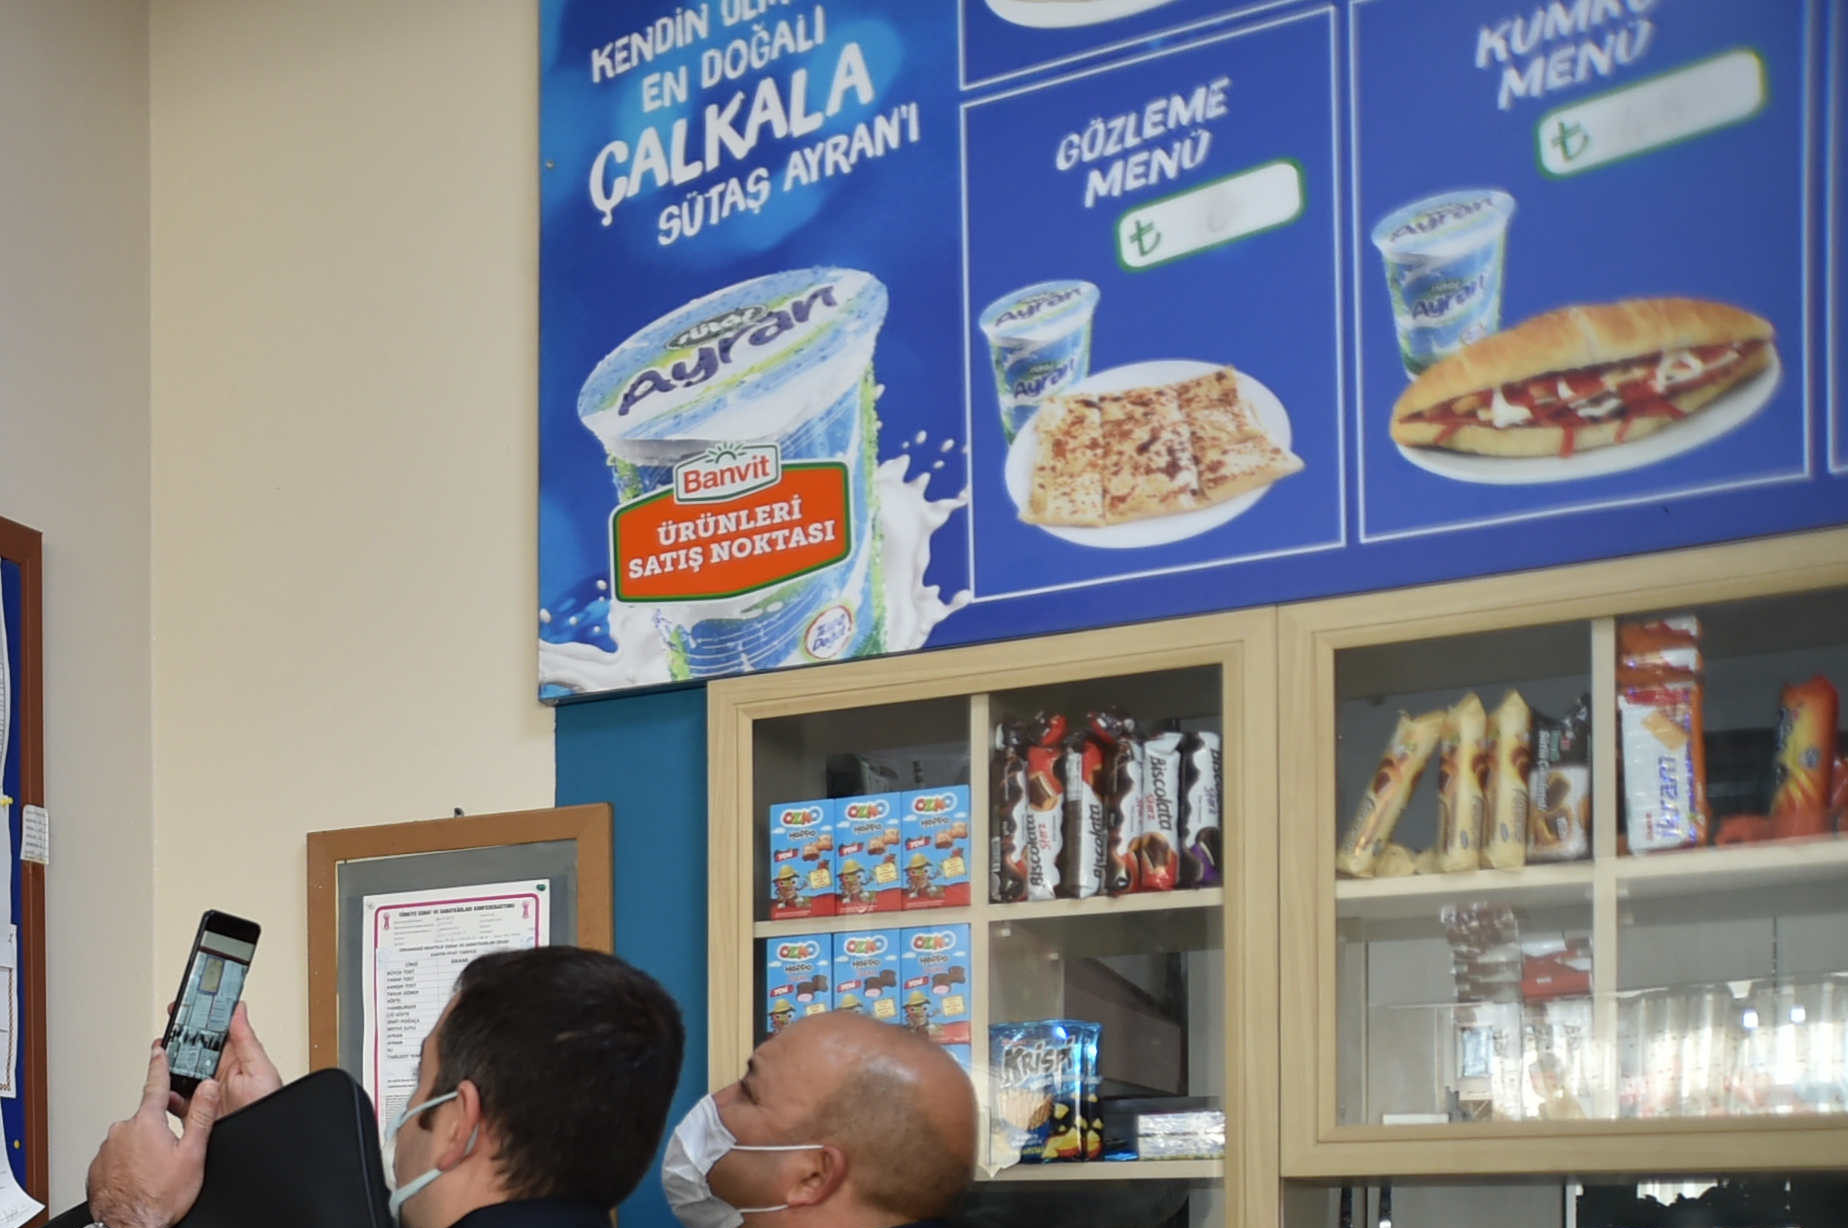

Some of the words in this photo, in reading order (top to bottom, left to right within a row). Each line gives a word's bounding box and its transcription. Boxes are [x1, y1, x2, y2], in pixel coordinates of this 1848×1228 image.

[591, 3, 709, 84] KENDİN
[1497, 17, 1656, 111] MENÜ
[641, 63, 689, 114] EN
[1055, 75, 1233, 172] GÖZLEME
[588, 40, 875, 227] ÇALKALA
[1083, 128, 1213, 209] MENÜ
[657, 166, 772, 247] SÜTAŞ
[782, 102, 921, 193] AYRAN'I
[683, 455, 770, 495] Banvit
[628, 546, 704, 580] SATIŞ
[711, 519, 836, 564] NOKTASI
[658, 494, 803, 546] ÜRÜNLERİ
